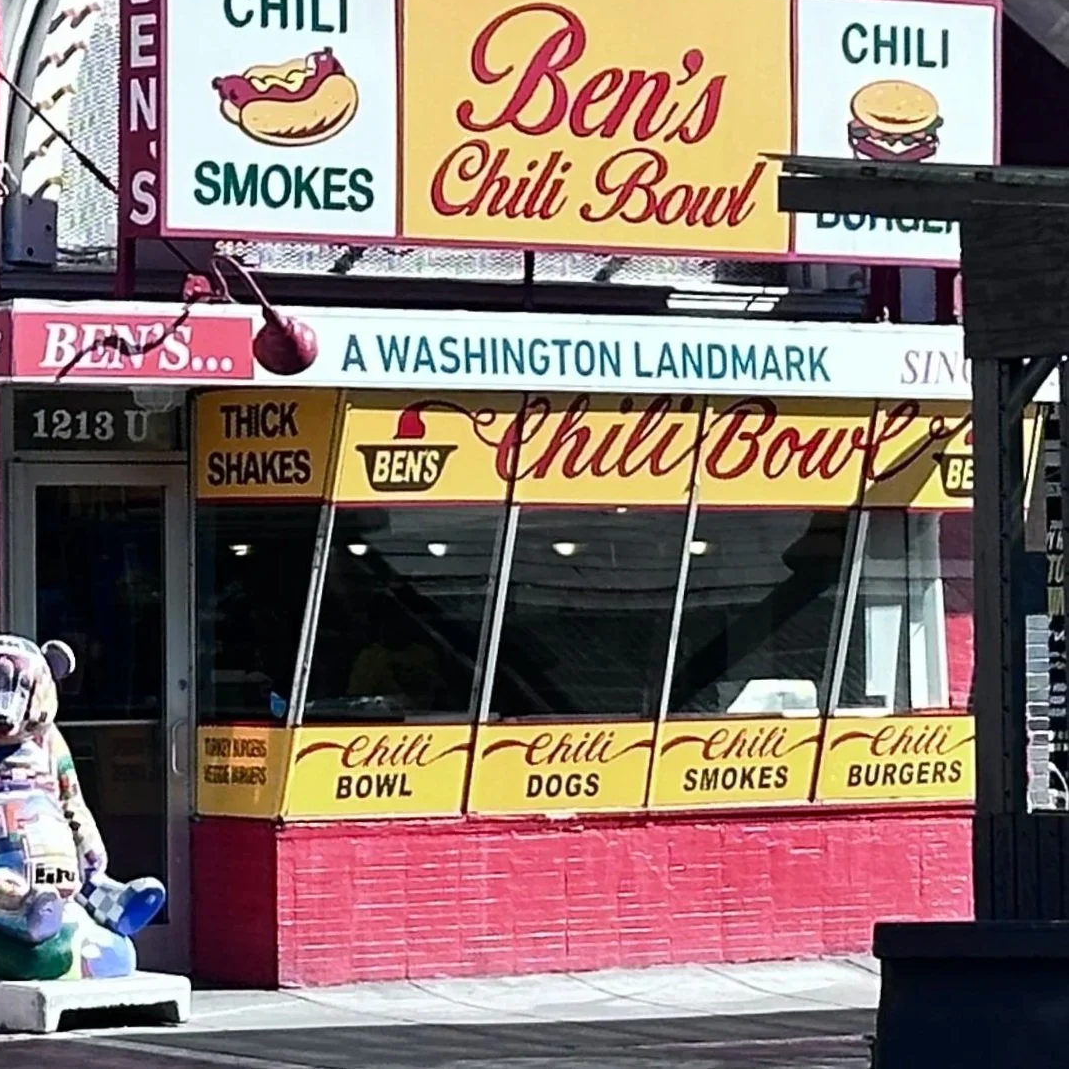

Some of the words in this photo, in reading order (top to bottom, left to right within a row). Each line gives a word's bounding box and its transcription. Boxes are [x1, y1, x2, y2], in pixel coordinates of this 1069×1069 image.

[842, 22, 949, 69] CHILI
[456, 2, 727, 144] Ben's
[194, 160, 374, 212] SMOKES
[431, 139, 573, 220] Chili
[580, 147, 767, 228] Bowl
[341, 334, 367, 372] A
[377, 334, 621, 377] WASHINGTON
[634, 341, 831, 381] LANDMARK
[32, 408, 115, 441] 1213
[125, 409, 148, 441] U
[220, 402, 299, 439] THICK
[495, 393, 688, 481] Chili
[704, 395, 921, 482] Bowl
[207, 449, 311, 487] SHAKES
[372, 448, 441, 484] BEN'S
[340, 733, 435, 768] Chili
[524, 731, 617, 765] Chili
[701, 726, 788, 761] Chili
[869, 724, 952, 757] Chili
[335, 773, 413, 799] BOWL
[525, 772, 600, 798] DOGS
[683, 764, 788, 792] SMOKES
[847, 759, 962, 788] BURGERS
